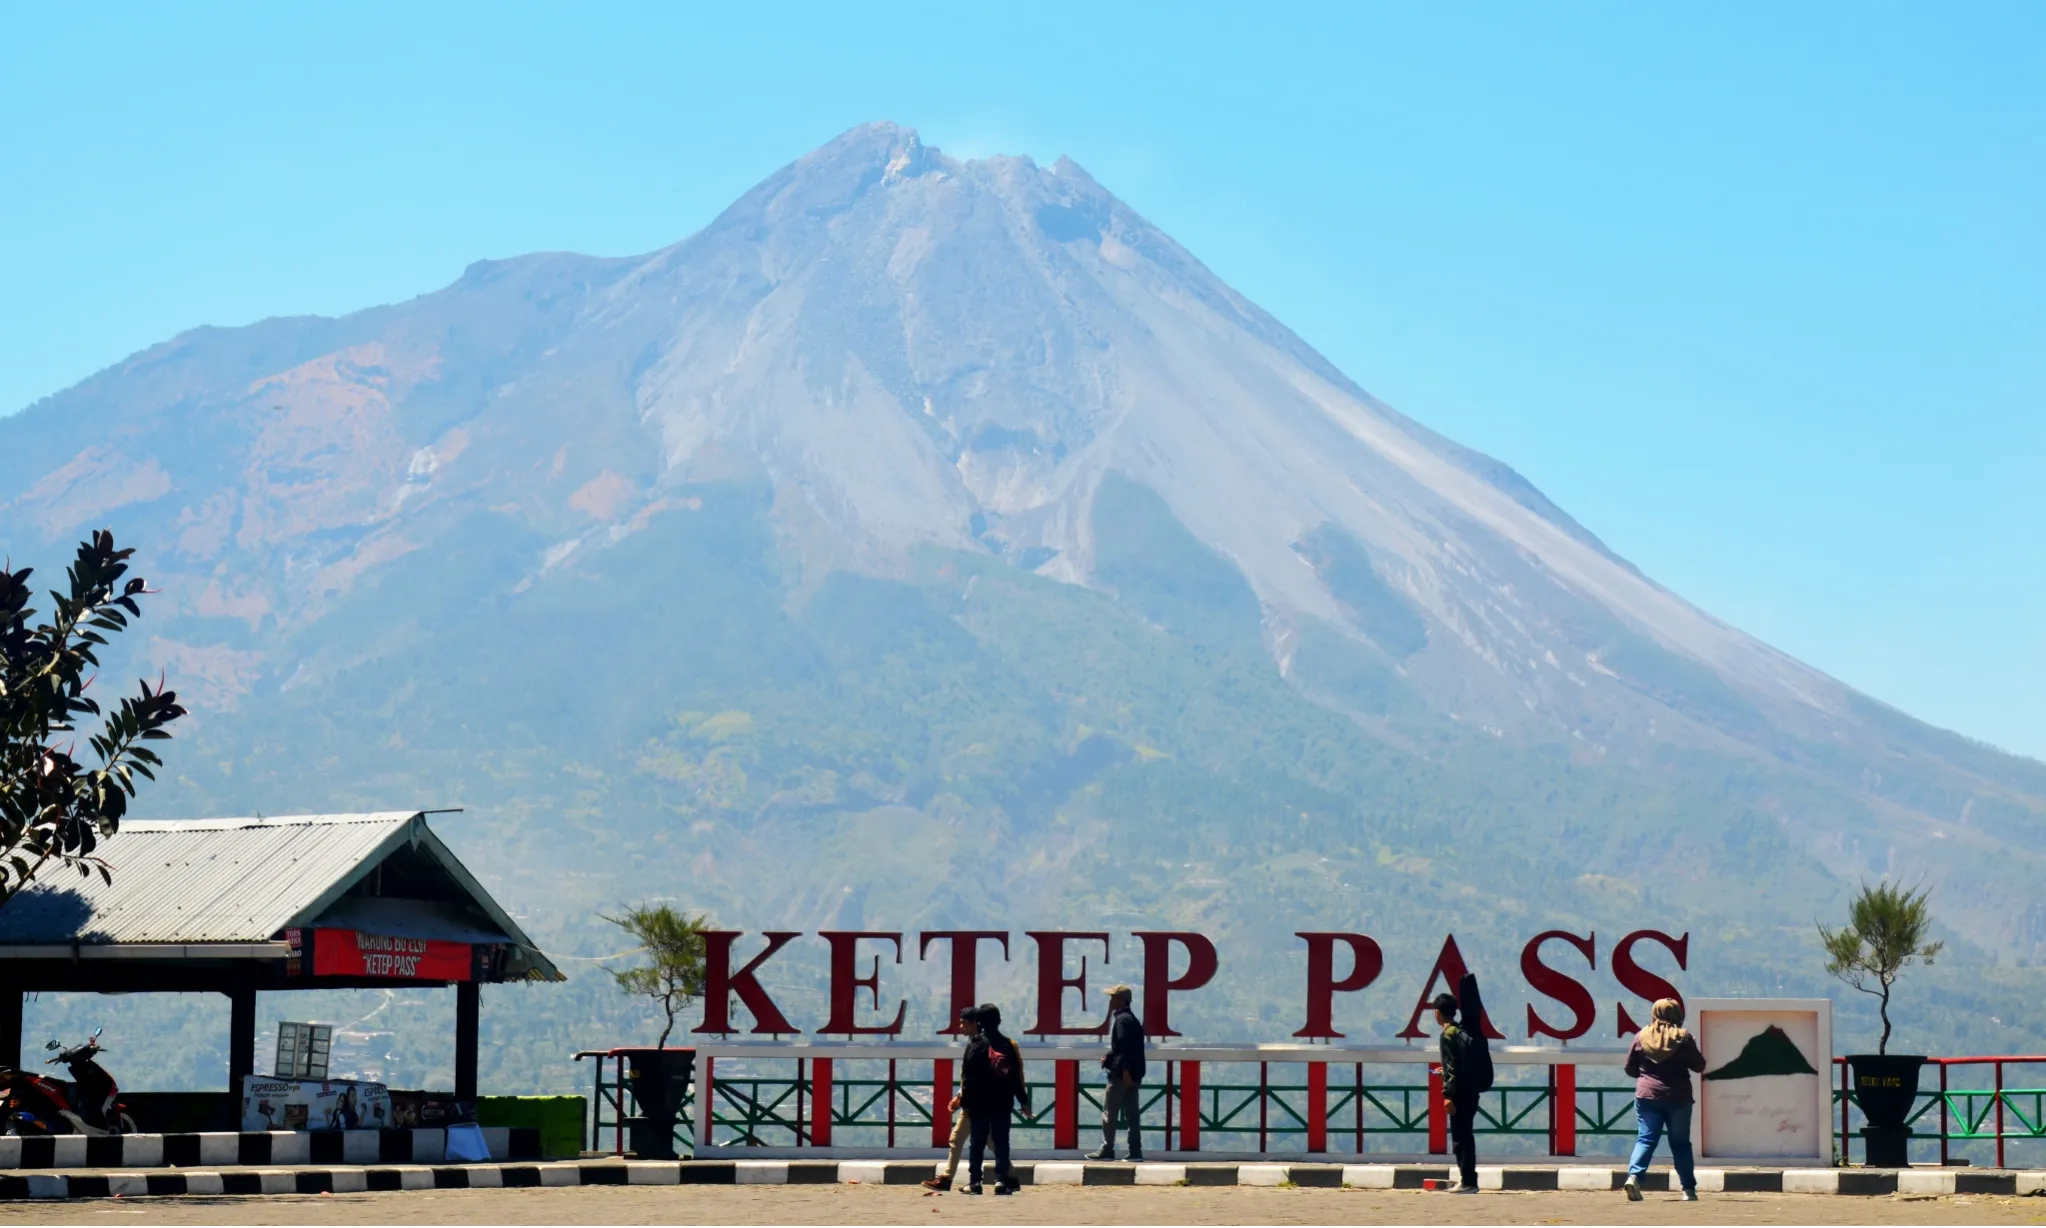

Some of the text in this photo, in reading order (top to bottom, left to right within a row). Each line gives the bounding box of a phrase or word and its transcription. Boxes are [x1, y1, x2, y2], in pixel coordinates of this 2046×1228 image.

[356, 931, 393, 951] WARUNG
[394, 936, 407, 952] BU
[362, 953, 422, 976] "KETEP PASS"
[691, 930, 1689, 1040] KETEP PASS
